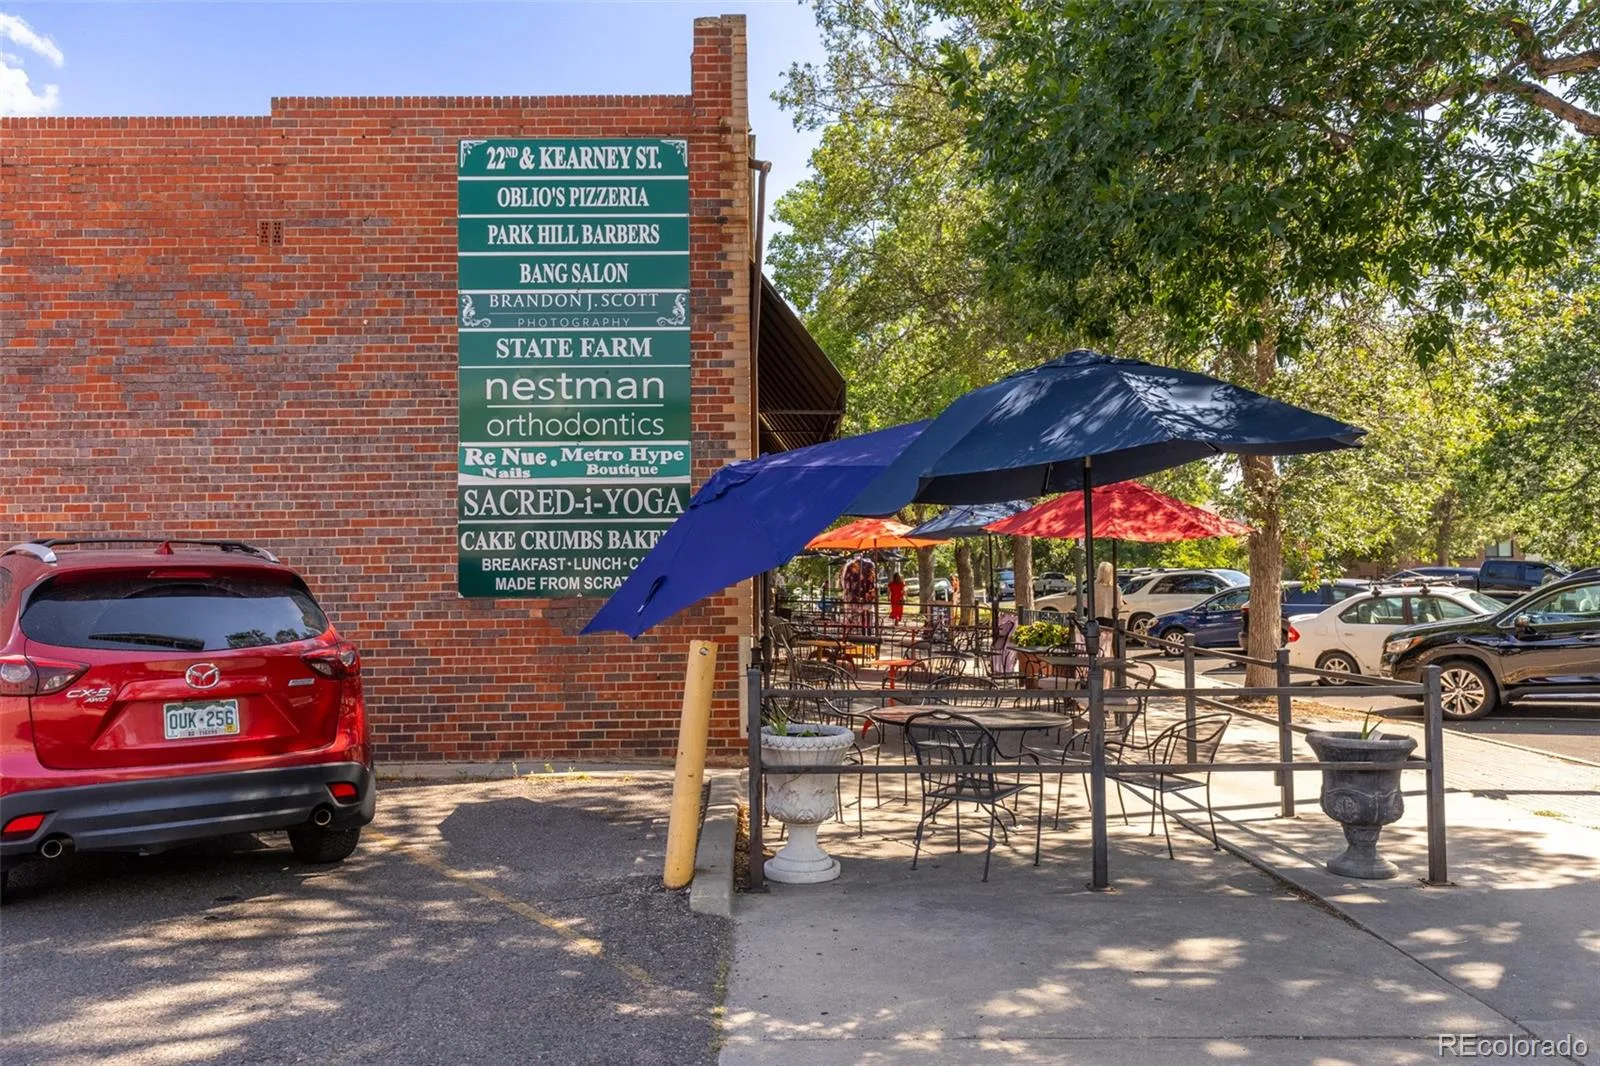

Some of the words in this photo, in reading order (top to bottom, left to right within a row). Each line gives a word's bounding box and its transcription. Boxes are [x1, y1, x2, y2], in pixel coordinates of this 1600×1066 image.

[486, 146, 518, 169] 22ND
[519, 146, 535, 169] &
[539, 146, 633, 169] KEARNEY
[635, 146, 662, 169] ST.
[497, 187, 566, 207] OBLIO'S
[569, 187, 650, 207] PIZZERIA
[487, 224, 534, 245] PARK
[537, 224, 580, 244] HILL
[581, 224, 660, 244] BARBERS
[520, 263, 568, 284] BANG
[571, 263, 629, 283] SALON
[489, 294, 582, 308] BRANDON
[586, 294, 598, 311] J.
[601, 293, 660, 308] SCOTT
[518, 317, 631, 328] PHOTOGRAPHY
[496, 337, 573, 359] STATE
[580, 337, 653, 358] FARM
[486, 372, 665, 400] nestman
[486, 412, 665, 437] orthodontics
[464, 448, 496, 466] Re
[560, 447, 624, 462] Metro
[629, 447, 684, 465] Hype
[481, 467, 531, 479] Nails
[586, 464, 659, 478] Boutique
[463, 487, 685, 516] SACRED-i-YOGA
[460, 531, 516, 551] CAKE
[520, 530, 603, 550] CRUMBS
[608, 530, 668, 549] BAKE
[481, 558, 566, 571] BREAKFAST
[573, 557, 622, 571] LUNCH
[495, 577, 536, 591] MADE
[540, 577, 580, 590] FROM
[66, 687, 112, 698] CX-5
